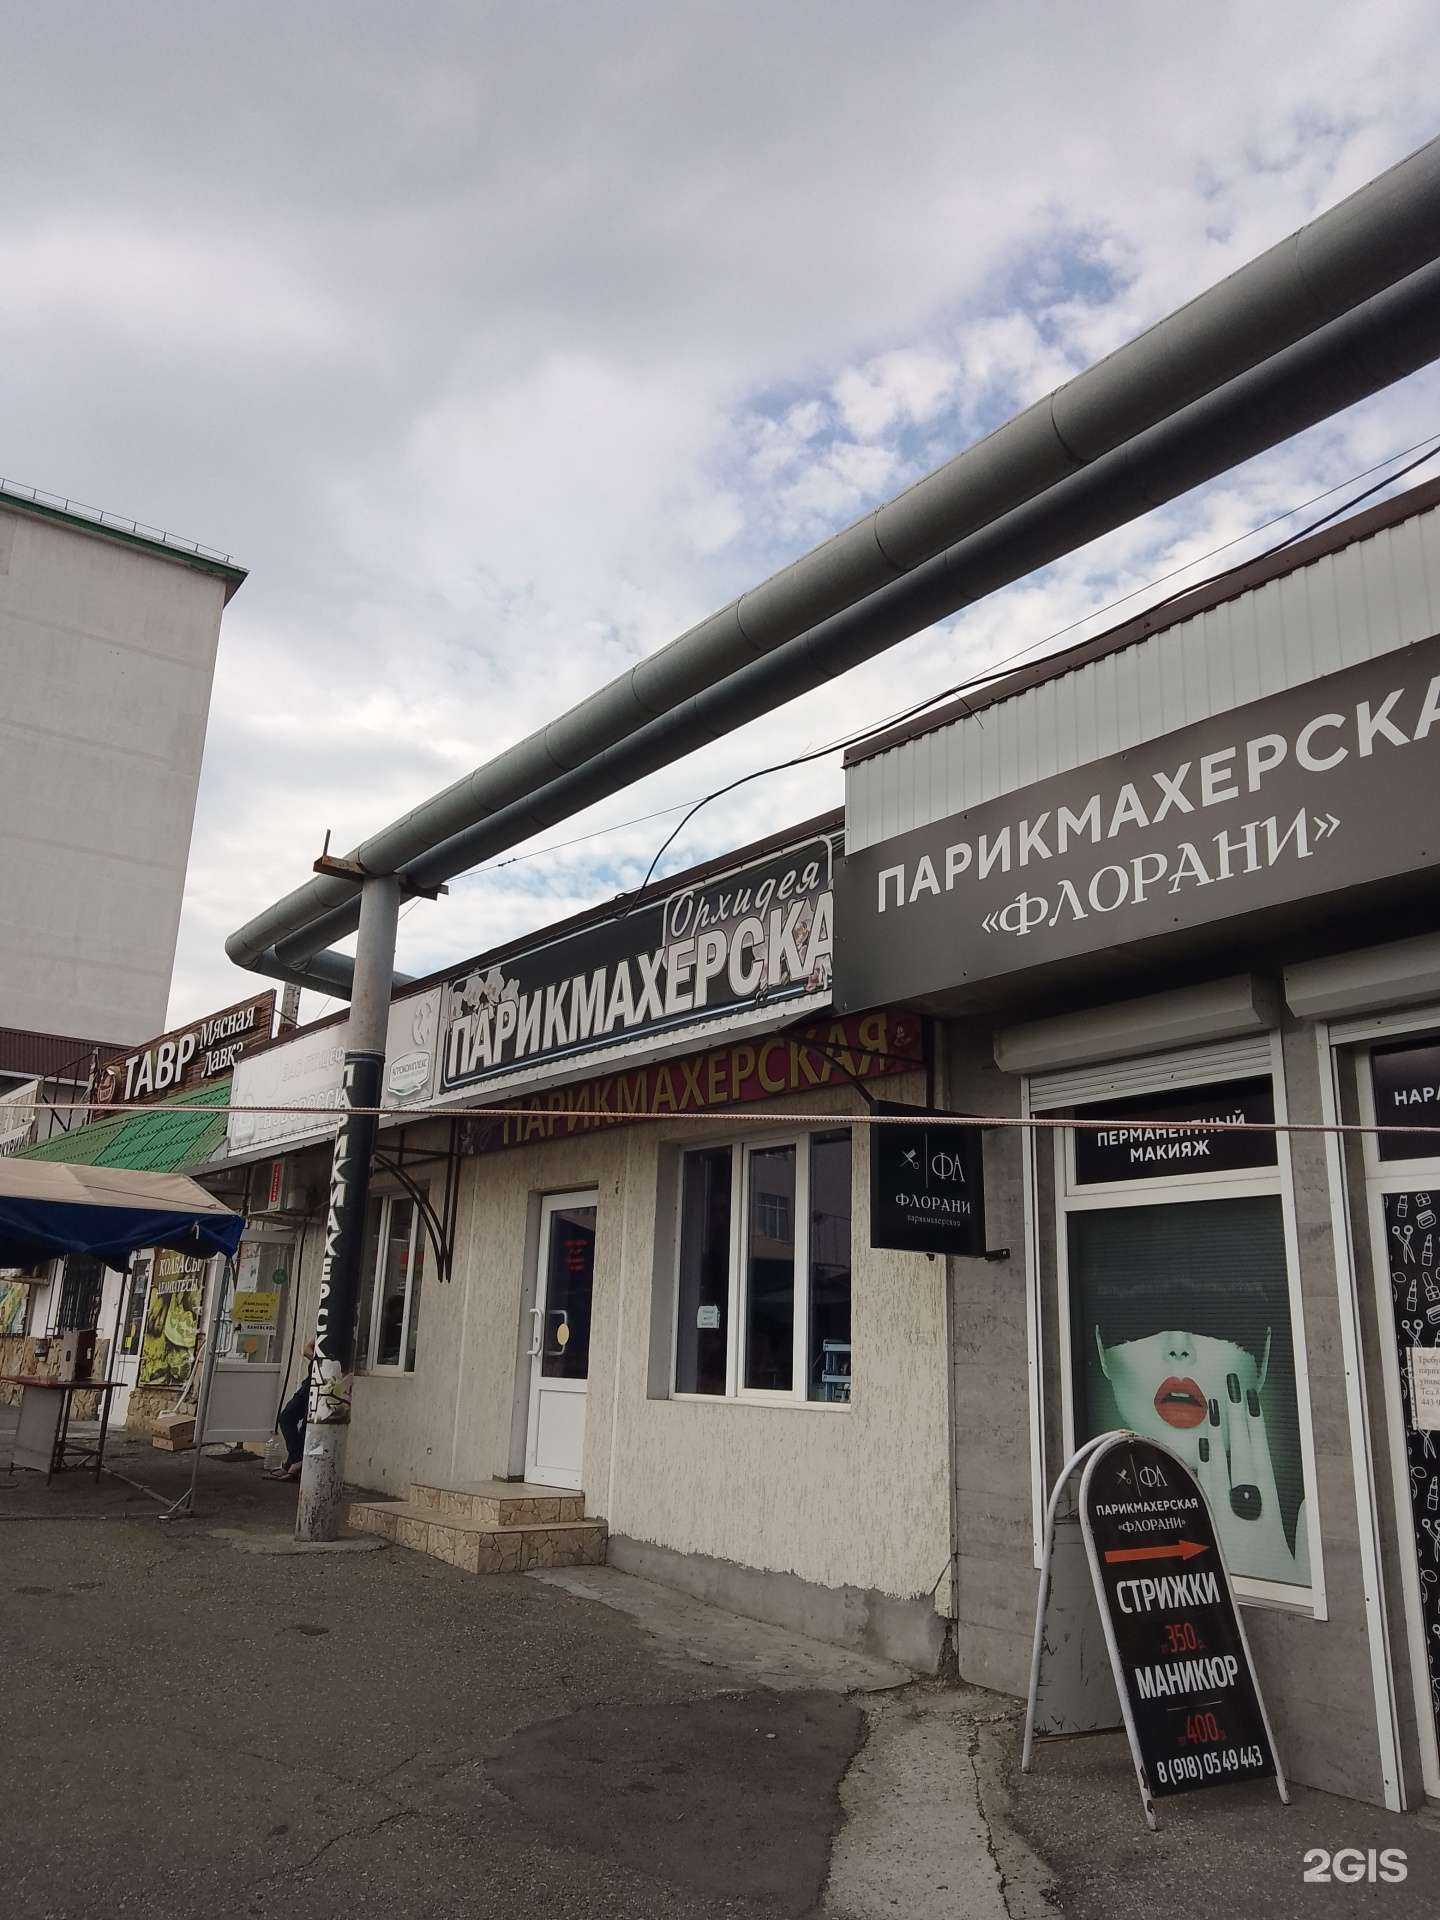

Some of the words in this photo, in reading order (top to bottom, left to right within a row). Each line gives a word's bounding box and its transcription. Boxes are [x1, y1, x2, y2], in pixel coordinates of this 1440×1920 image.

[877, 676, 1440, 912] ПАРИКМАХЕРСКА
[981, 807, 1341, 936] «ФЛОРАНИ»
[671, 861, 820, 937] Орхидея
[447, 889, 833, 1077] ПАРИКМАХЕРСКА
[200, 1006, 256, 1050] Мясная
[124, 1033, 196, 1101] ТАВР
[502, 1013, 889, 1146] ПАРИКМАХЕРСКАЯ
[1130, 1139, 1211, 1163] МАКИЯЖ
[895, 1193, 971, 1214] ФЛОРАНИ
[1096, 1498, 1199, 1516] ПАРИКМАХЕРСКАЯ
[1118, 1517, 1186, 1533] «ФЛОРАНИ»
[1116, 1571, 1221, 1614] СТРИЖКИ
[1166, 1622, 1197, 1653] 350
[1135, 1655, 1238, 1700] МАНИКЮР
[1187, 1712, 1219, 1745] 400
[1157, 1761, 1168, 1784] 8
[1168, 1754, 1204, 1785] (918)
